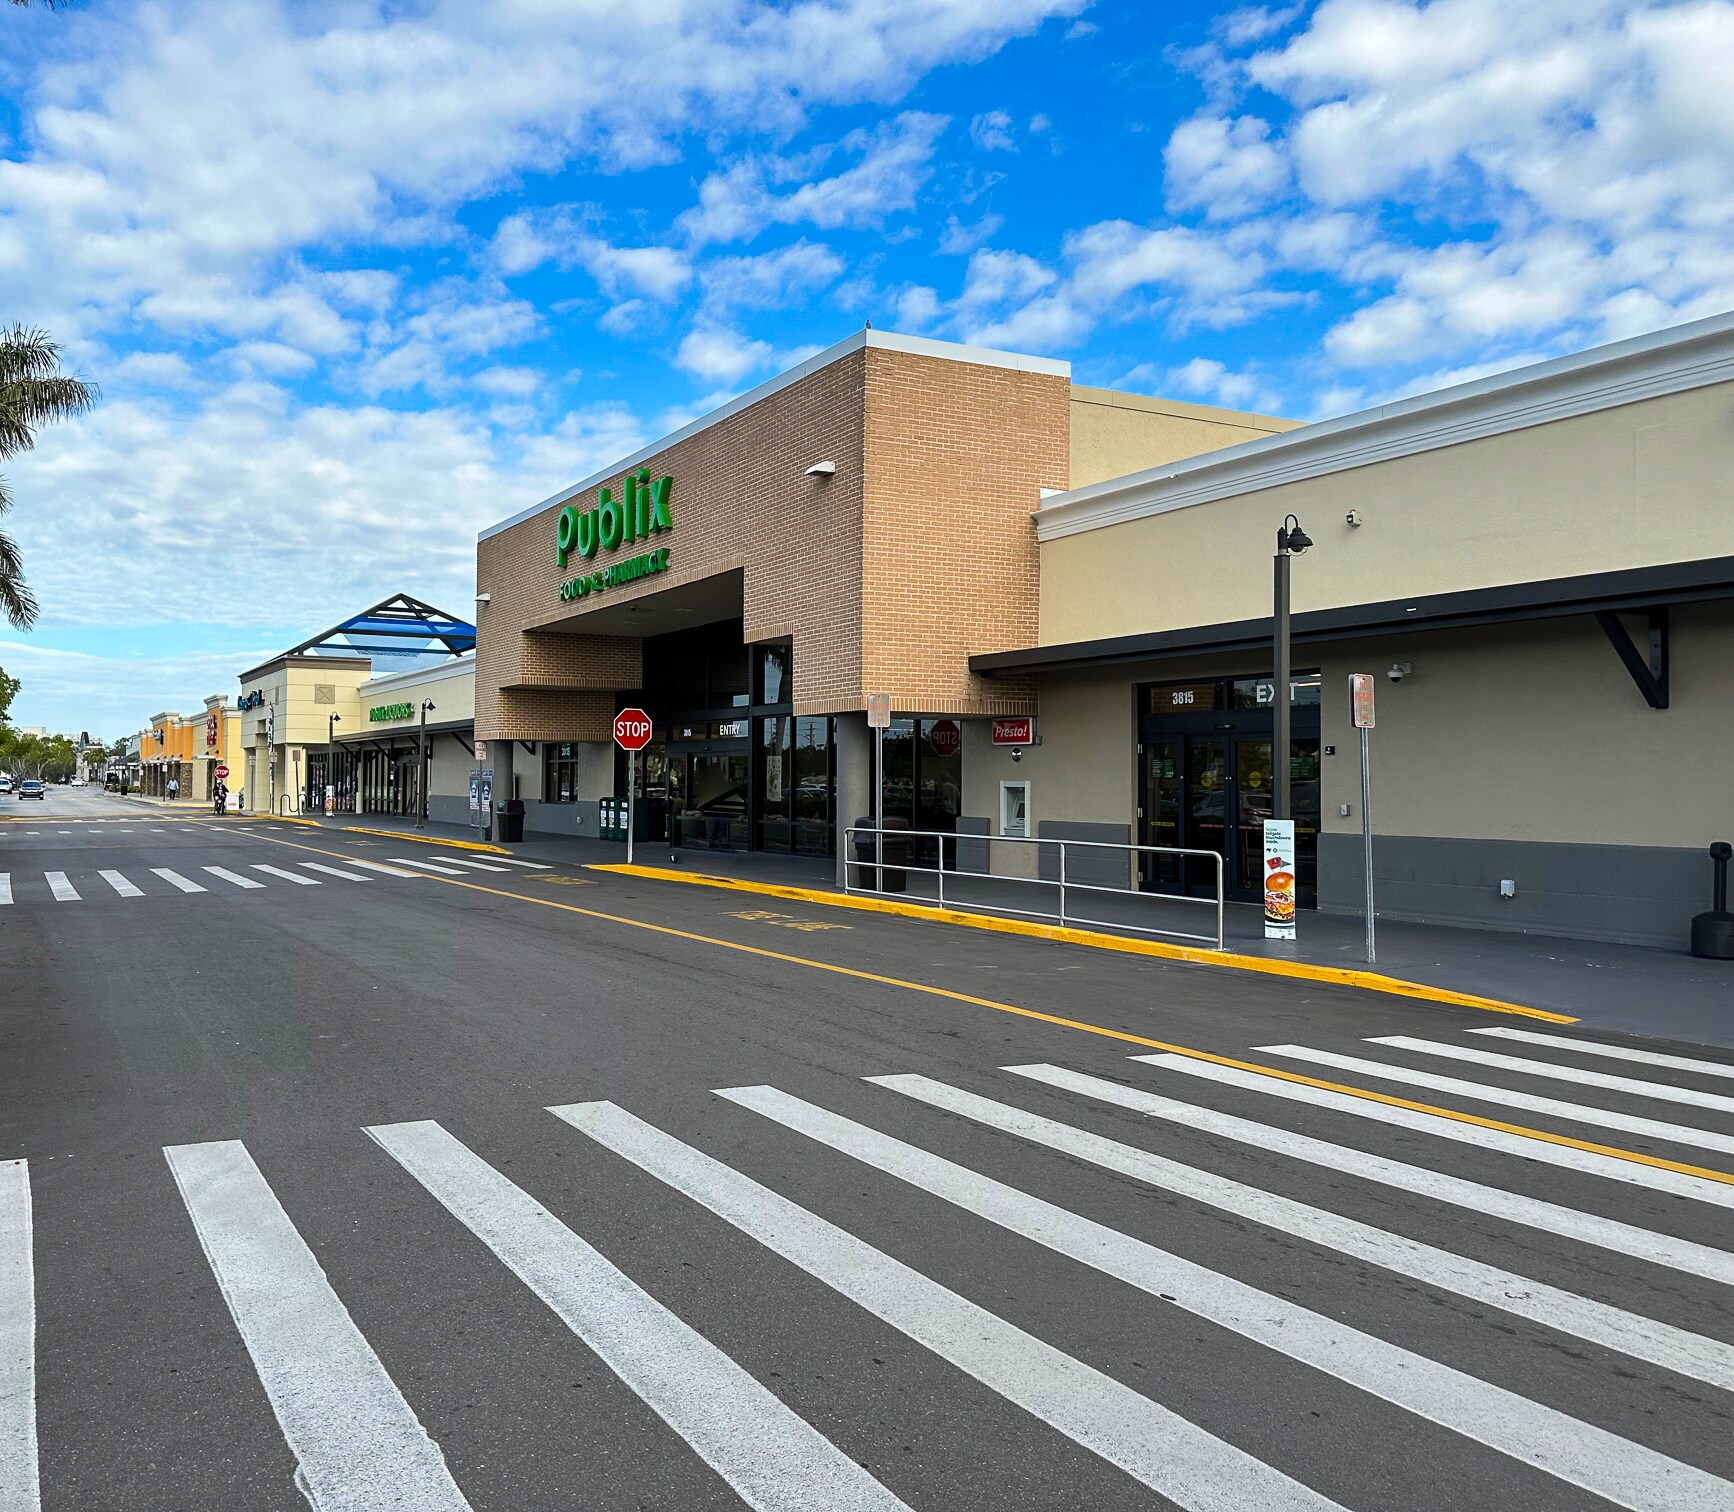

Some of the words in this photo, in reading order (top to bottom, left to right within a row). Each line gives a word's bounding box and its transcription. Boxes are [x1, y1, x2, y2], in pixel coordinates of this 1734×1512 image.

[557, 467, 673, 568] Publix
[560, 575, 591, 602] FOOD
[591, 571, 604, 592] &
[603, 547, 671, 588] PHARMACY
[1172, 691, 1194, 705] 3815
[616, 721, 649, 737] STOP
[719, 724, 740, 736] ENTRY
[995, 724, 1028, 738] Presto!
